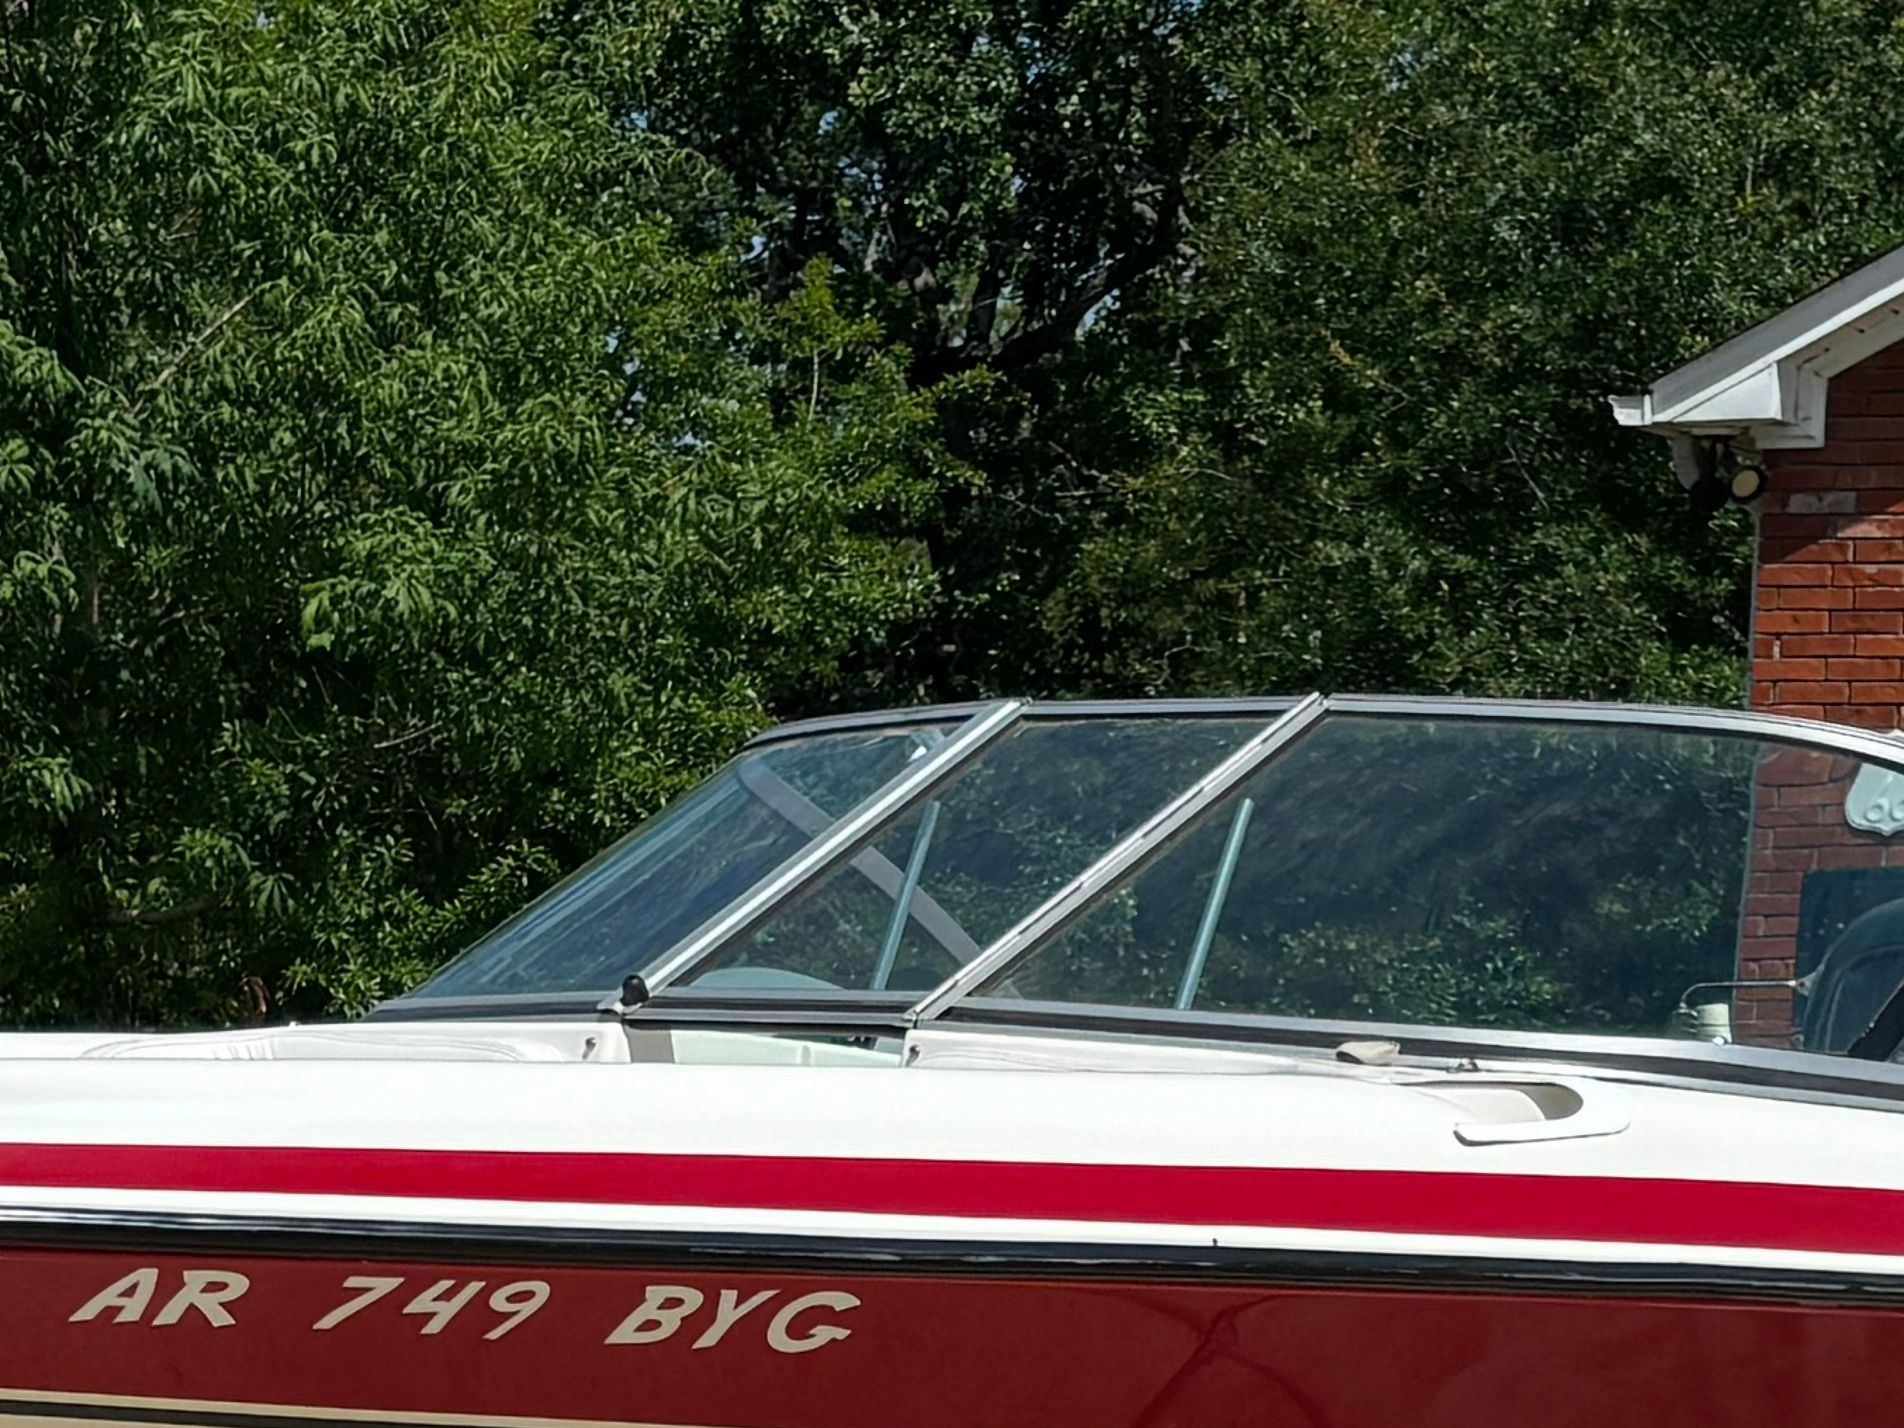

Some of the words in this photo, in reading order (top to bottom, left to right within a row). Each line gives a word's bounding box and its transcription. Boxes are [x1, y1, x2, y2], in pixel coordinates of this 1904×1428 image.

[68, 1267, 250, 1328] AR
[312, 1275, 551, 1341] 749
[603, 1284, 862, 1354] BYG
